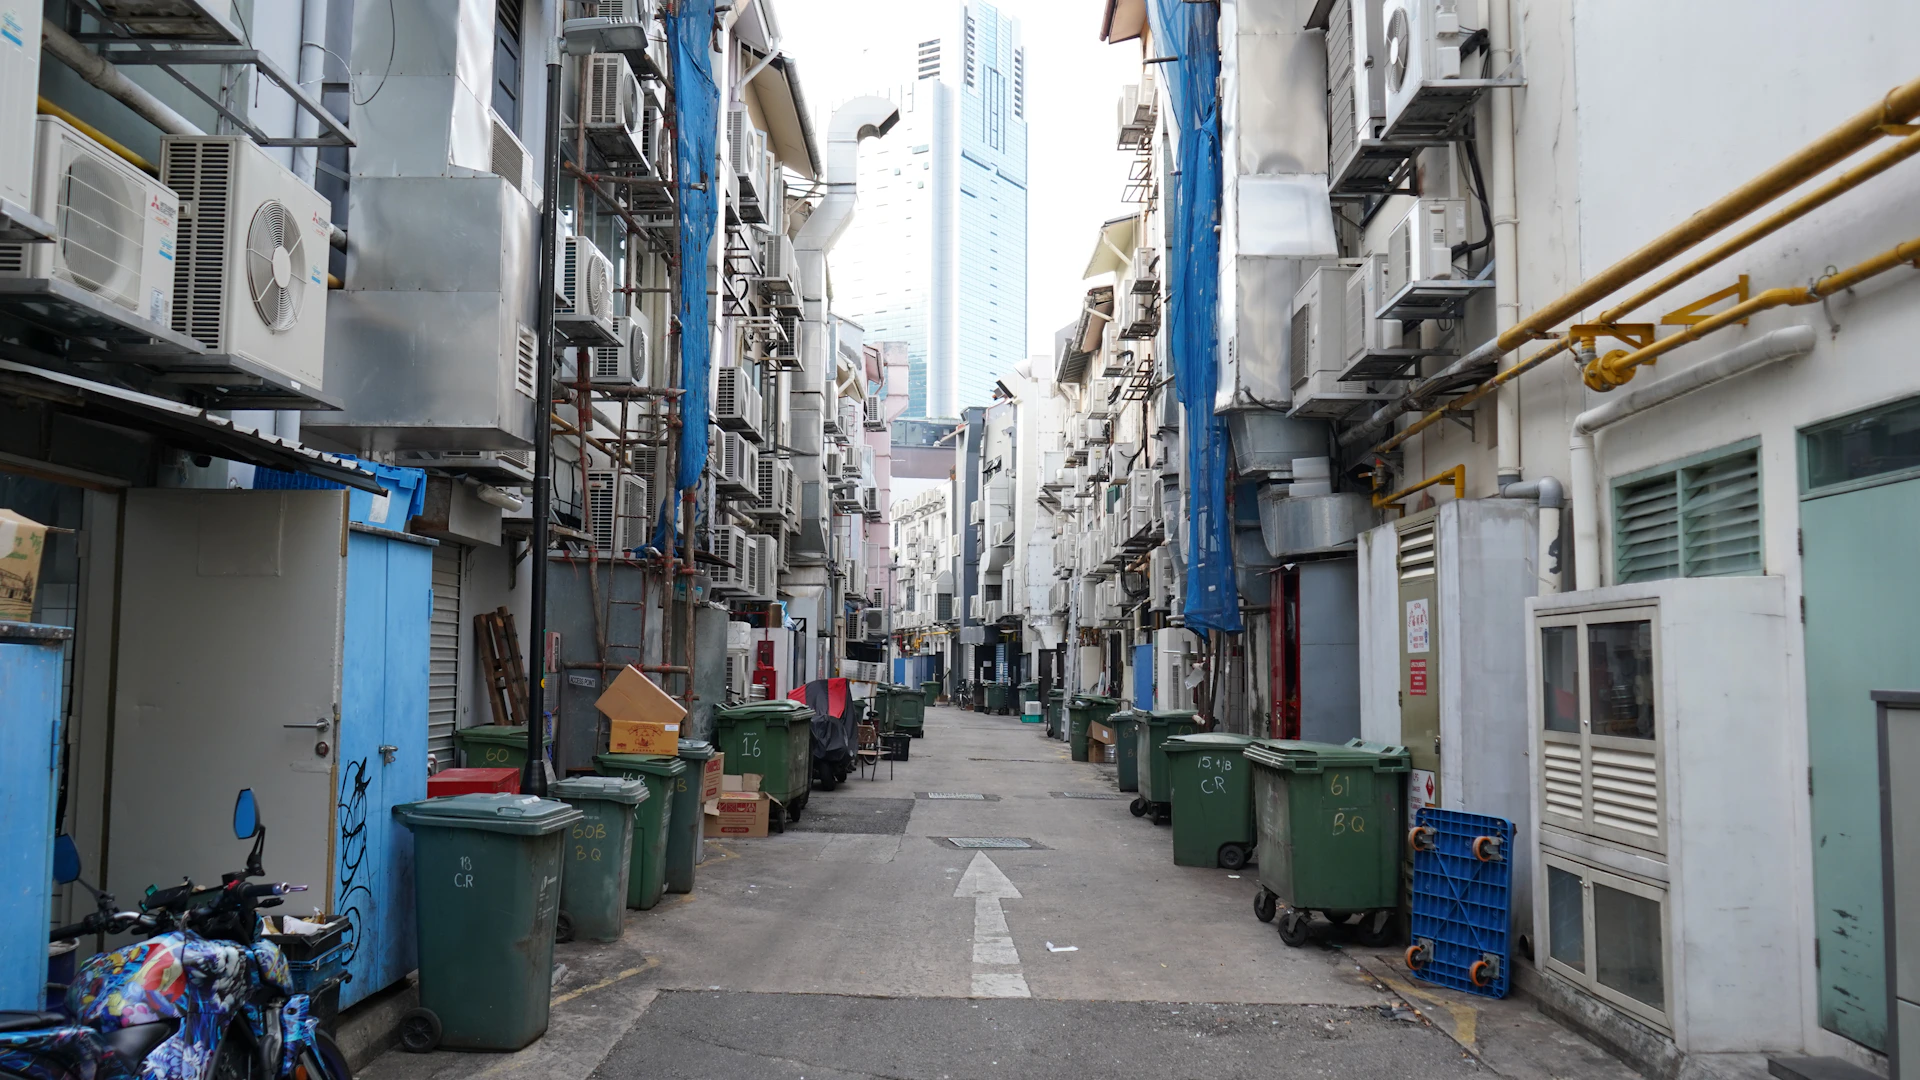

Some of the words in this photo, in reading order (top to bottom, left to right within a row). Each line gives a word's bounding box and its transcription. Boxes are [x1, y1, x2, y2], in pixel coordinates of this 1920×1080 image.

[486, 747, 509, 763] 60
[741, 737, 762, 758] 16
[677, 778, 688, 792] B
[1331, 774, 1350, 797] 61
[572, 823, 607, 840] 60B
[459, 856, 473, 871] 18
